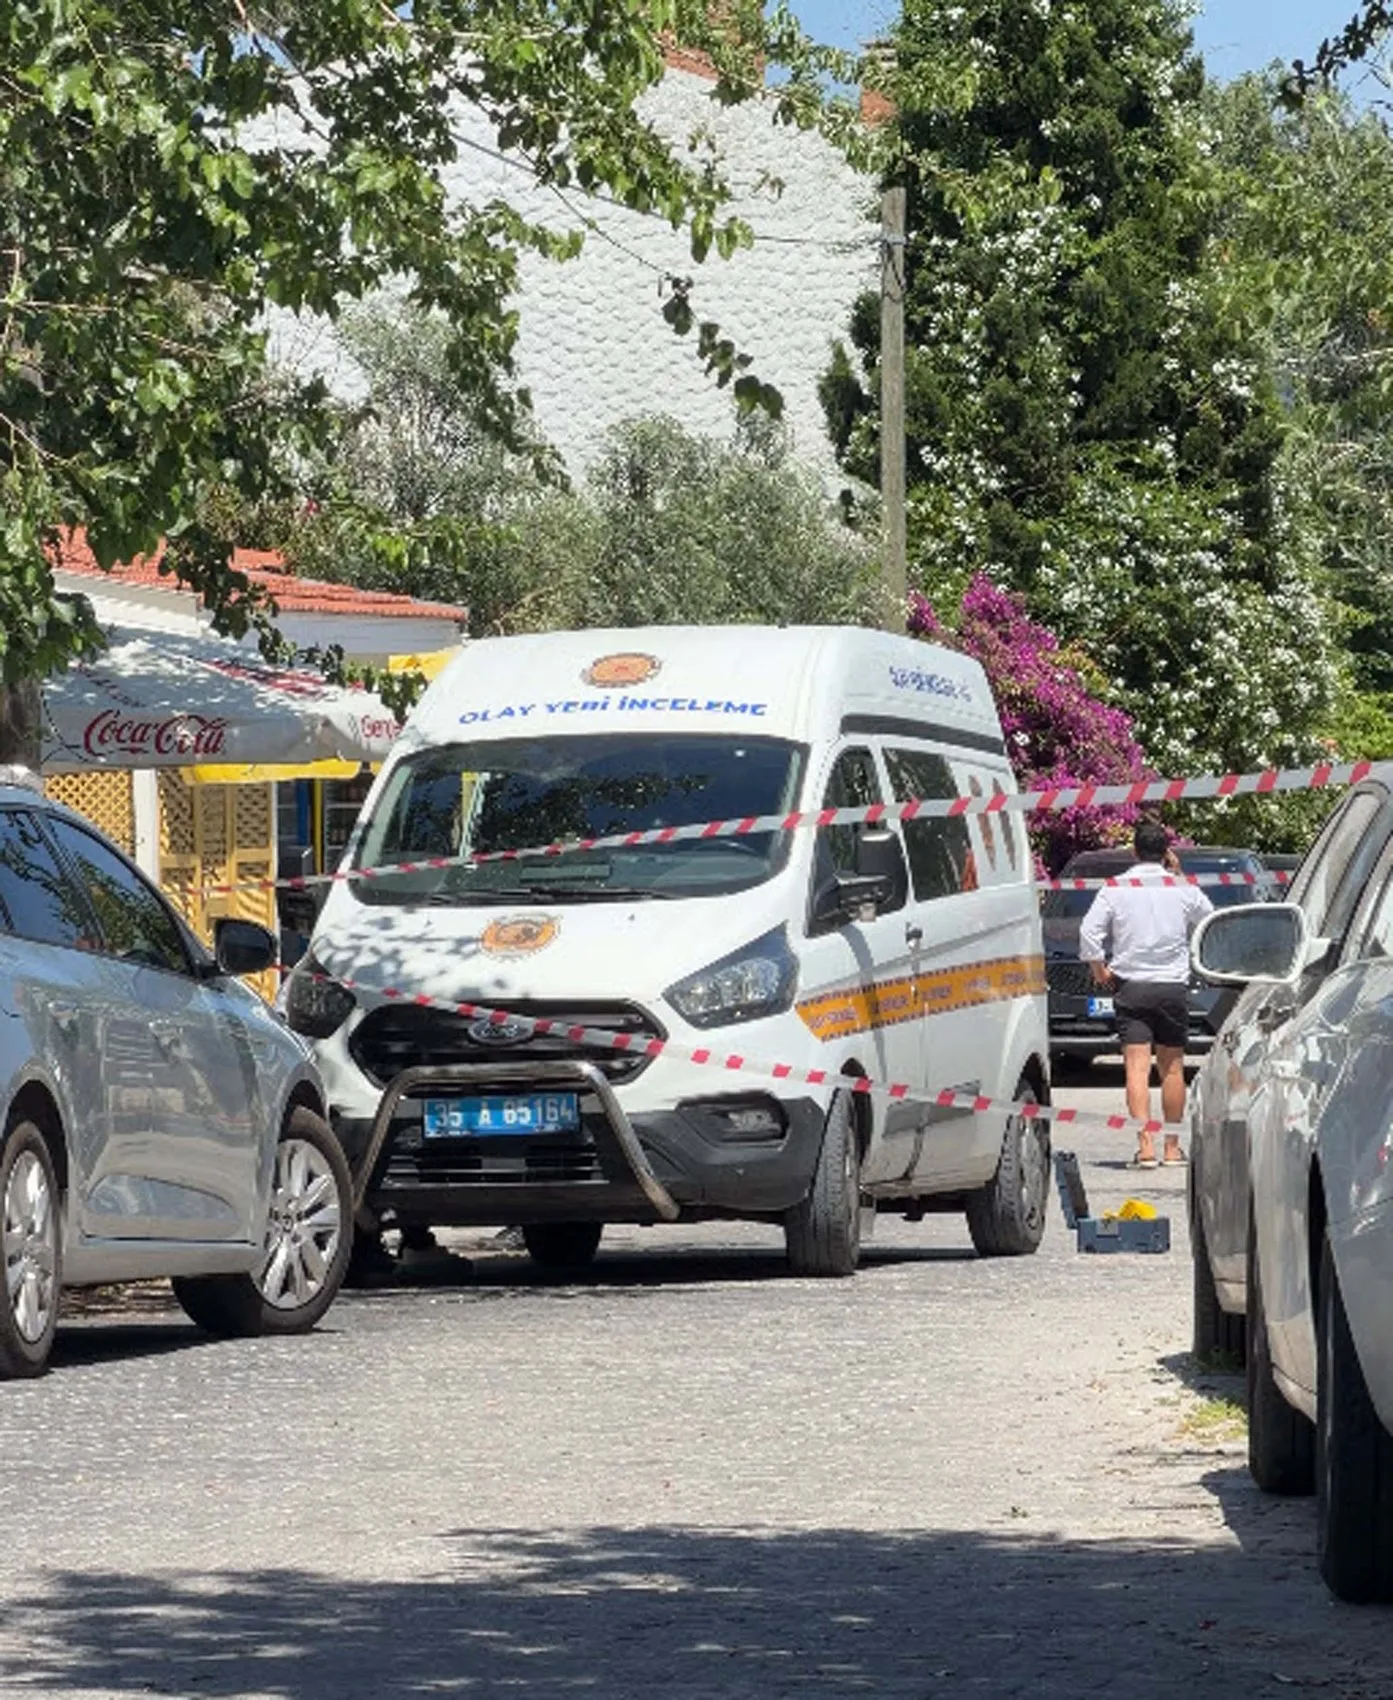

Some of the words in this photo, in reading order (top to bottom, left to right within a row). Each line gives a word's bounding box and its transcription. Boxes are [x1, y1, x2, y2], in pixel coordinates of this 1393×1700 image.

[459, 703, 536, 724] OLAY
[617, 695, 767, 716] İNCELEME
[84, 709, 230, 756] Coca-Cola
[435, 1102, 463, 1127] 35
[478, 1101, 492, 1126] A
